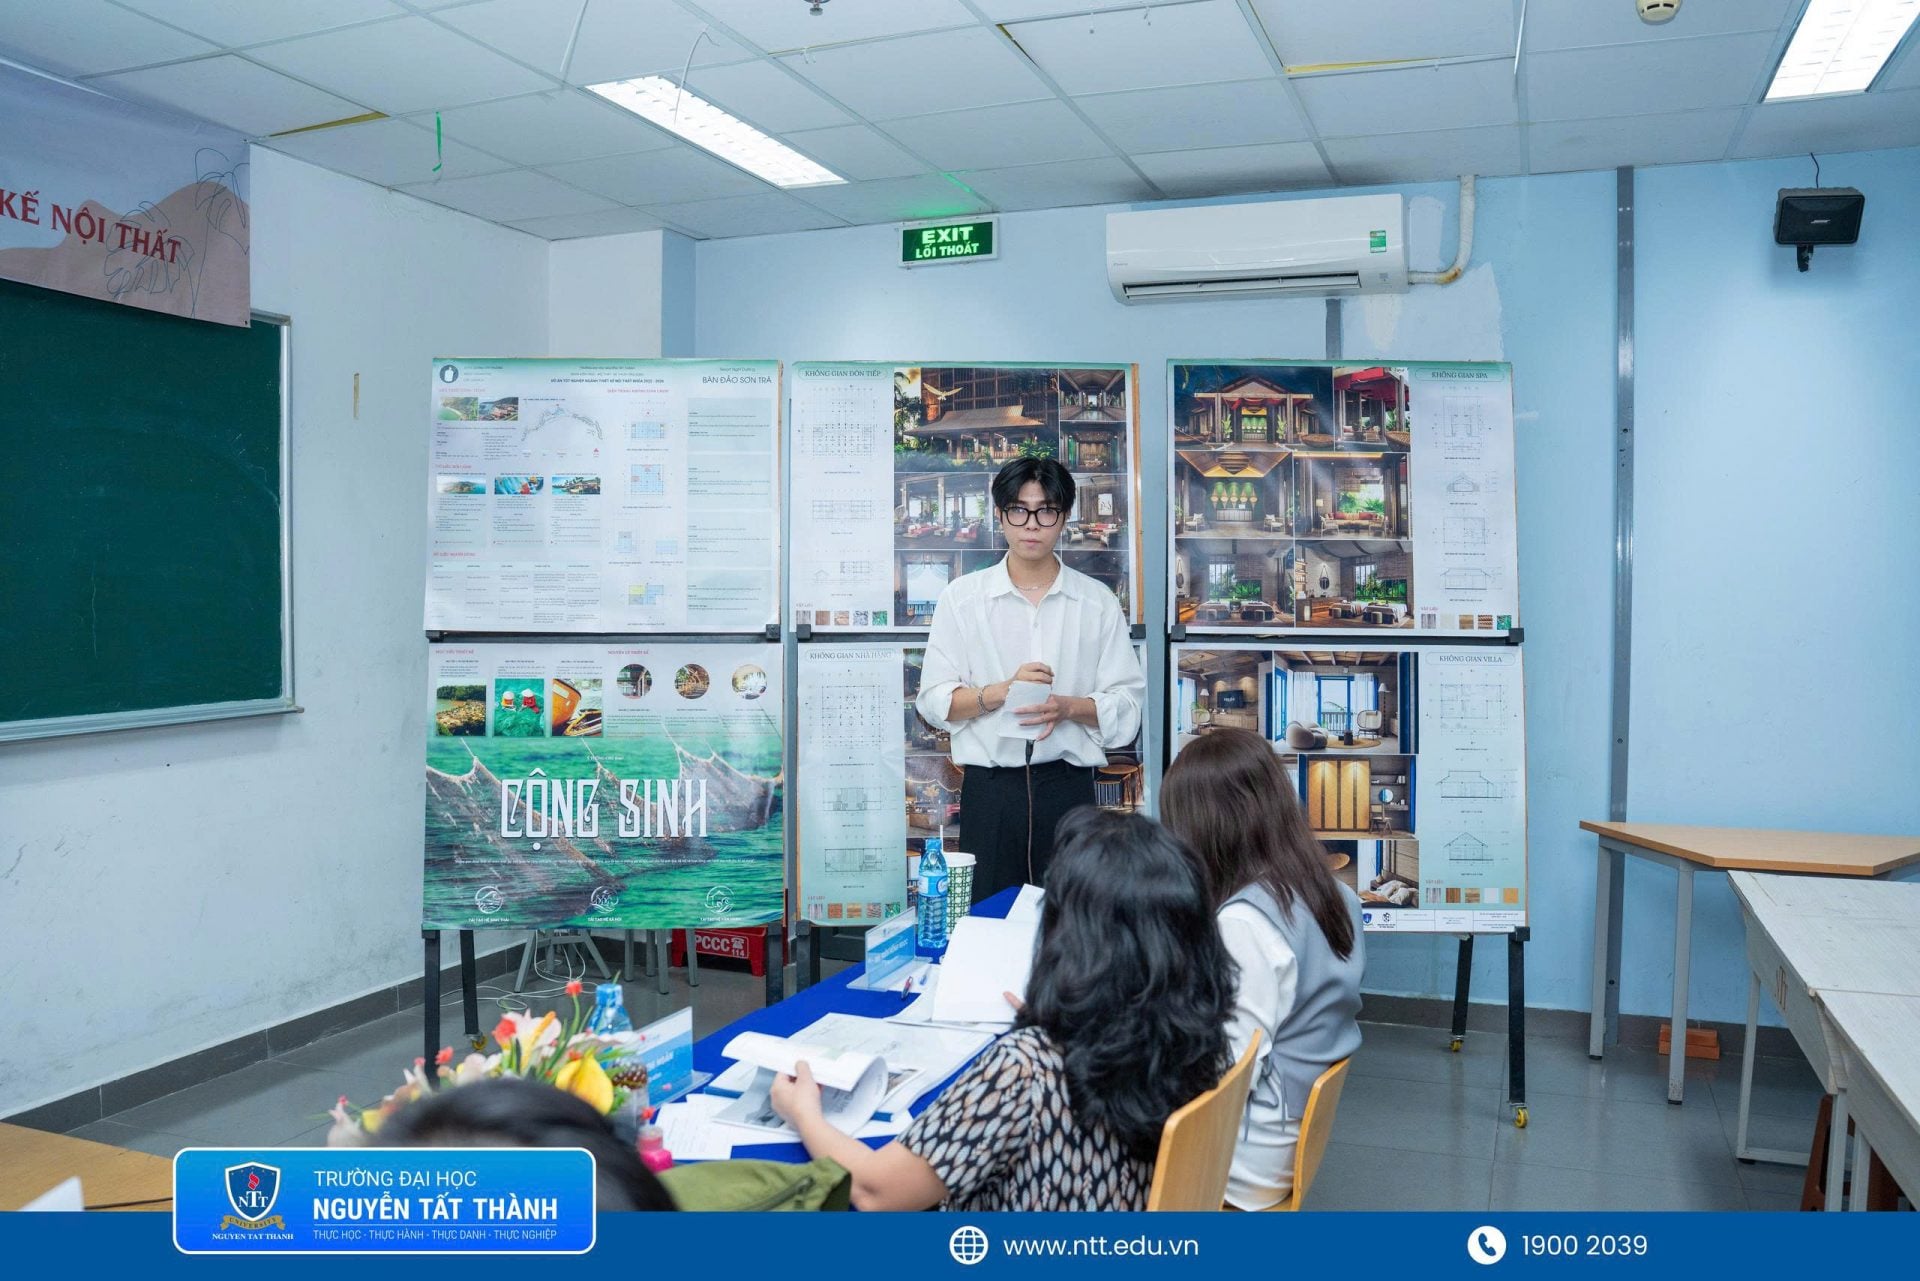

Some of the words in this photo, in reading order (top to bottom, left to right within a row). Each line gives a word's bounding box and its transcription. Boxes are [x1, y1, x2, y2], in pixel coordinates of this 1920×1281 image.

[0, 189, 39, 225] KẾ
[51, 203, 105, 245] NỘI
[115, 222, 181, 263] THẤT
[922, 226, 973, 244] EXIT
[915, 243, 937, 258] LỐI
[939, 241, 979, 256] THOÁT
[805, 368, 830, 377] KHÔNG
[810, 651, 835, 659] KHÔNG
[1440, 654, 1464, 662] KHÔNG
[501, 767, 600, 851] CỘNG
[618, 778, 708, 838] SINH
[695, 935, 730, 952] PCCC
[732, 949, 744, 957] 114
